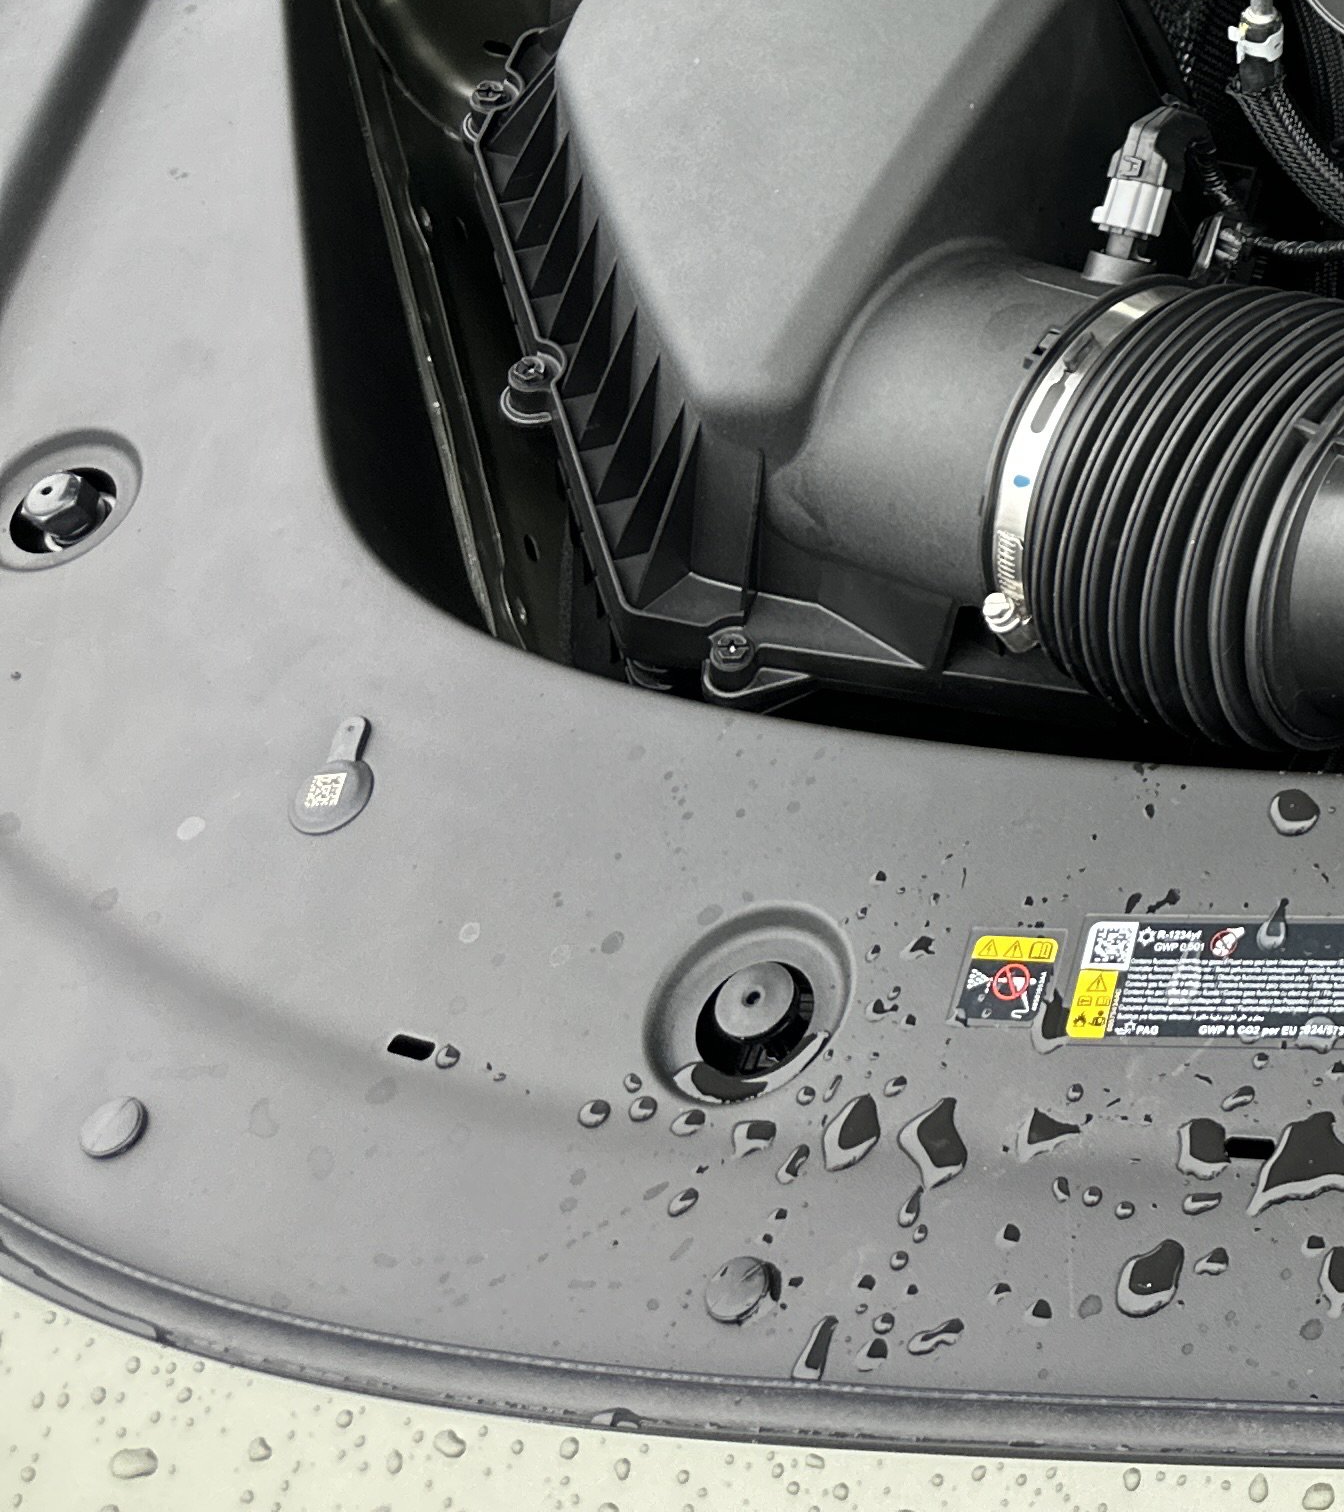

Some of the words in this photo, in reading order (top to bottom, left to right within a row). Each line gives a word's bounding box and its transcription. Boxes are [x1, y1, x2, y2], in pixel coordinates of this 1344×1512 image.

[1156, 929, 1203, 942] R-1234yf
[1153, 941, 1179, 952] GWP
[1136, 1025, 1160, 1036] PAG
[1198, 1024, 1226, 1036] GWP
[1226, 1024, 1236, 1036] &
[1237, 1025, 1261, 1036] CO2
[1261, 1028, 1281, 1038] per
[1281, 1026, 1298, 1036] EU
